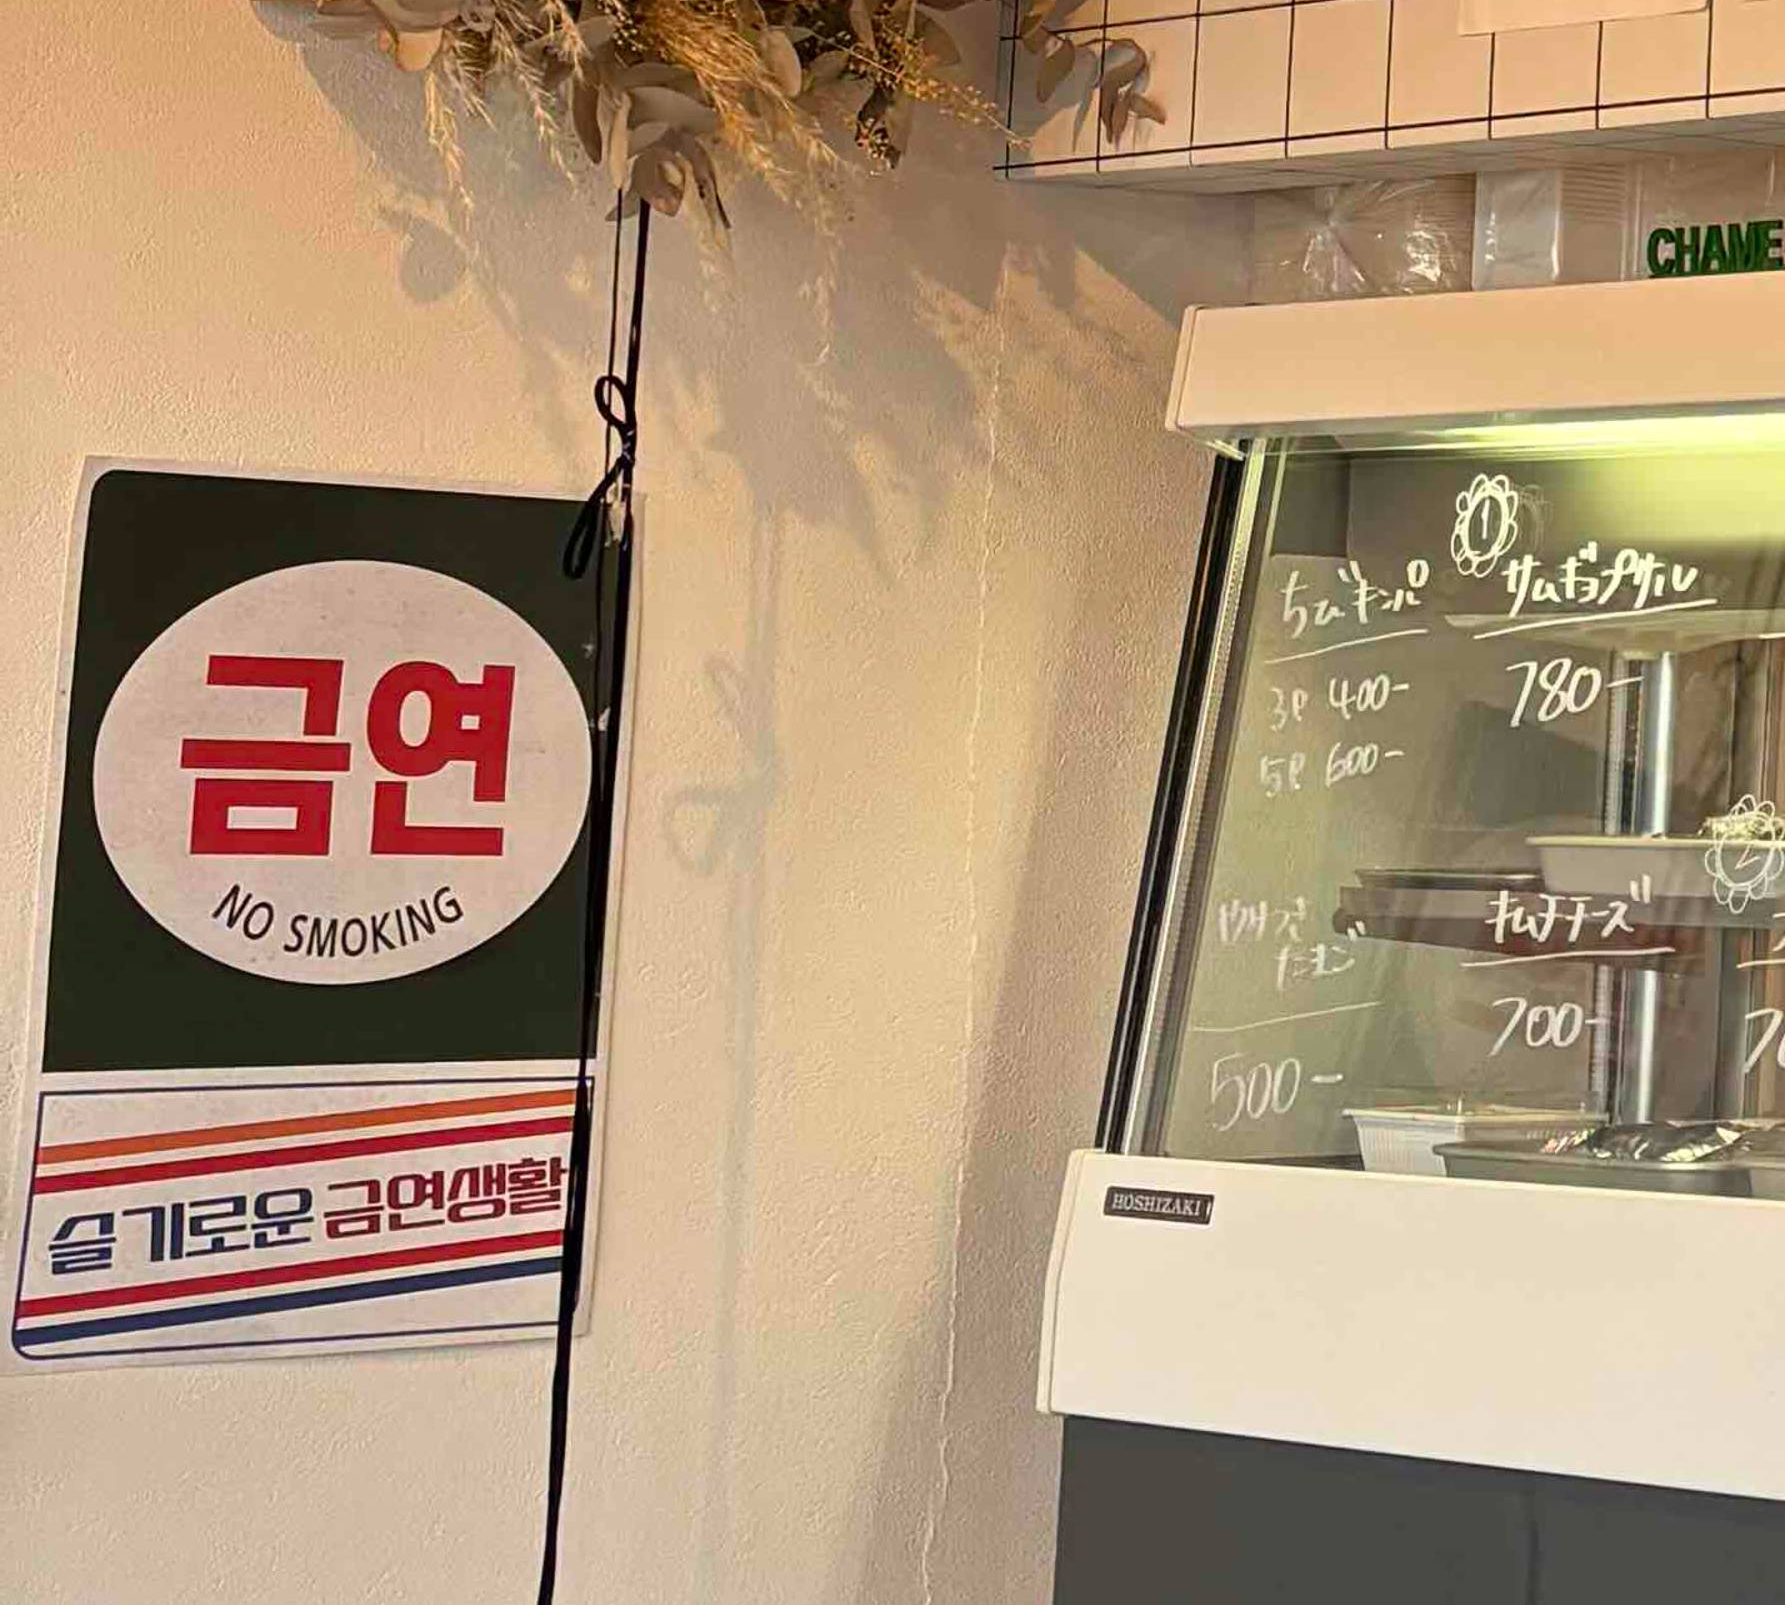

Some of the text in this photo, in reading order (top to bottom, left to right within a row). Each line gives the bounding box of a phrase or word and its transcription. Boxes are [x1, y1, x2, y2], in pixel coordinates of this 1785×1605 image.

[1648, 218, 1783, 277] CHAME
[1506, 658, 1644, 729] 780-
[180, 654, 516, 857] 금연
[212, 884, 463, 959] NO SMOKING
[1487, 875, 1653, 944] キムチチーズ
[1208, 1053, 1344, 1132] 500-
[49, 1155, 570, 1276] 슬기로운 금연생활
[1112, 1193, 1201, 1216] HOSHIZAKI
